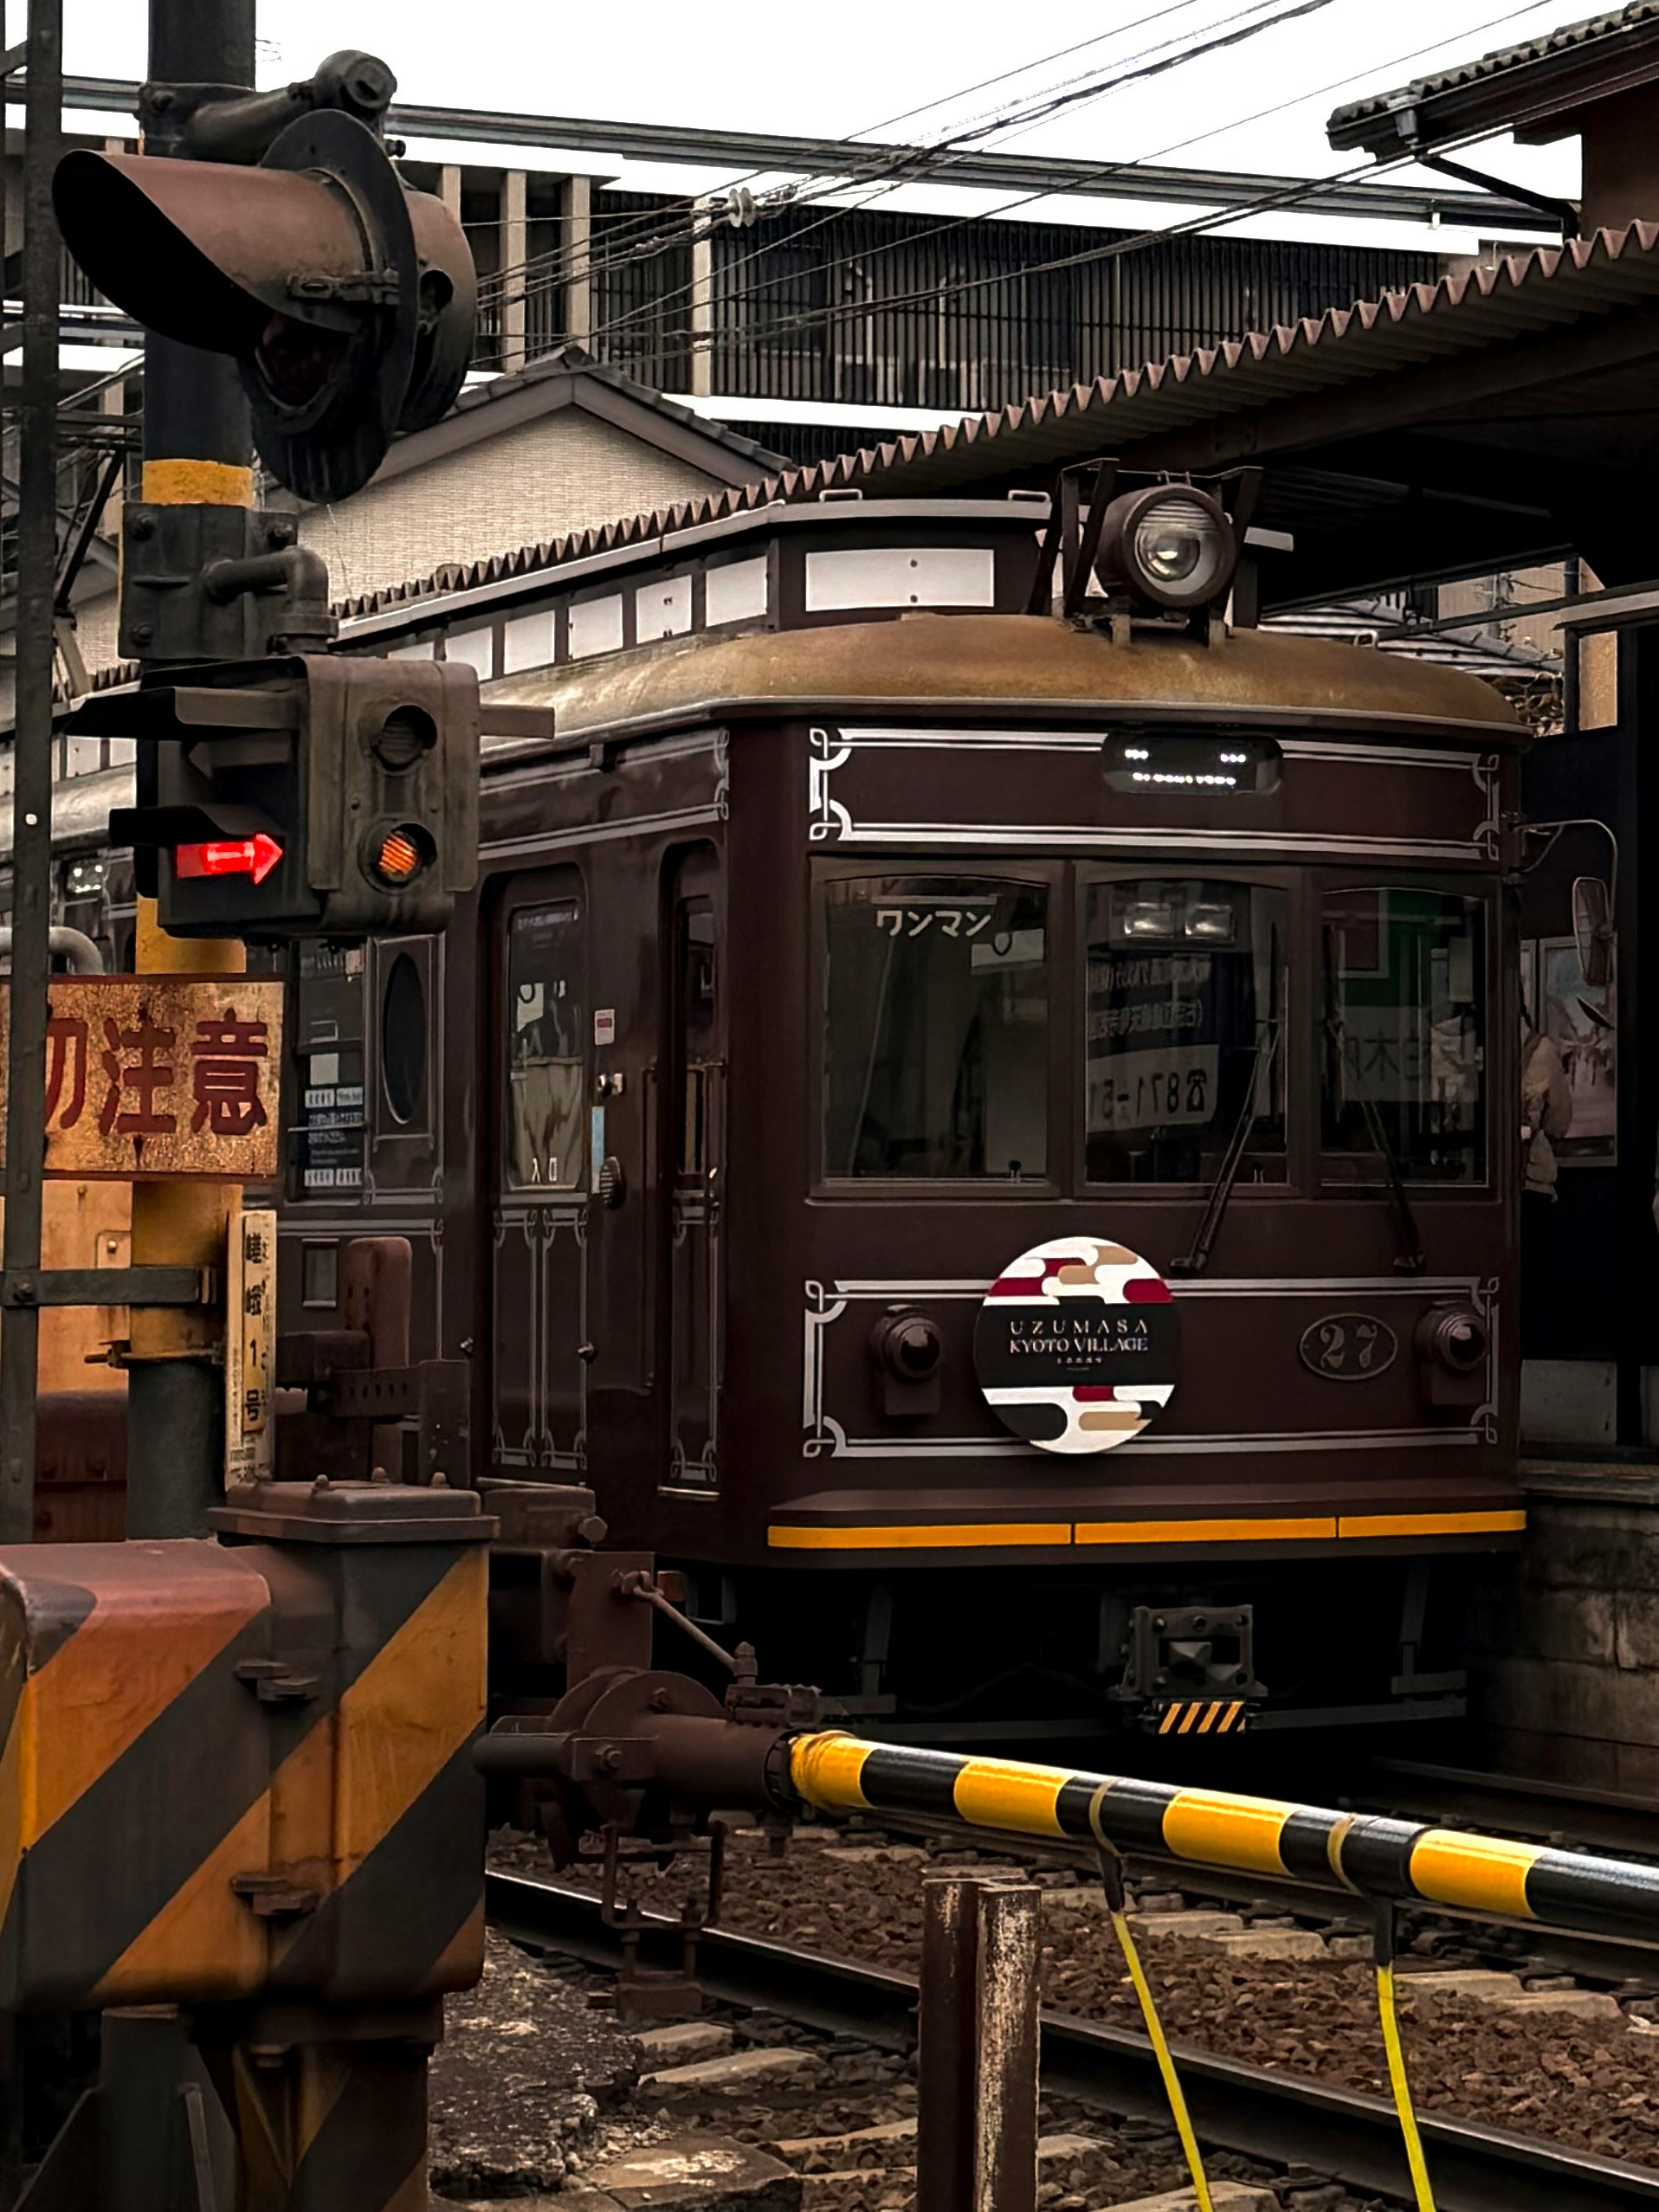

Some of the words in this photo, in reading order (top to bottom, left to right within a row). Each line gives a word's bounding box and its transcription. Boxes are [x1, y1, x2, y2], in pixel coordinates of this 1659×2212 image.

[876, 910, 991, 937] ワンマン
[1010, 1319, 1148, 1335] UZUMASA
[1010, 1337, 1070, 1353] KYOTO
[1074, 1337, 1148, 1352] VILLAGE
[1320, 1324, 1378, 1369] 27
